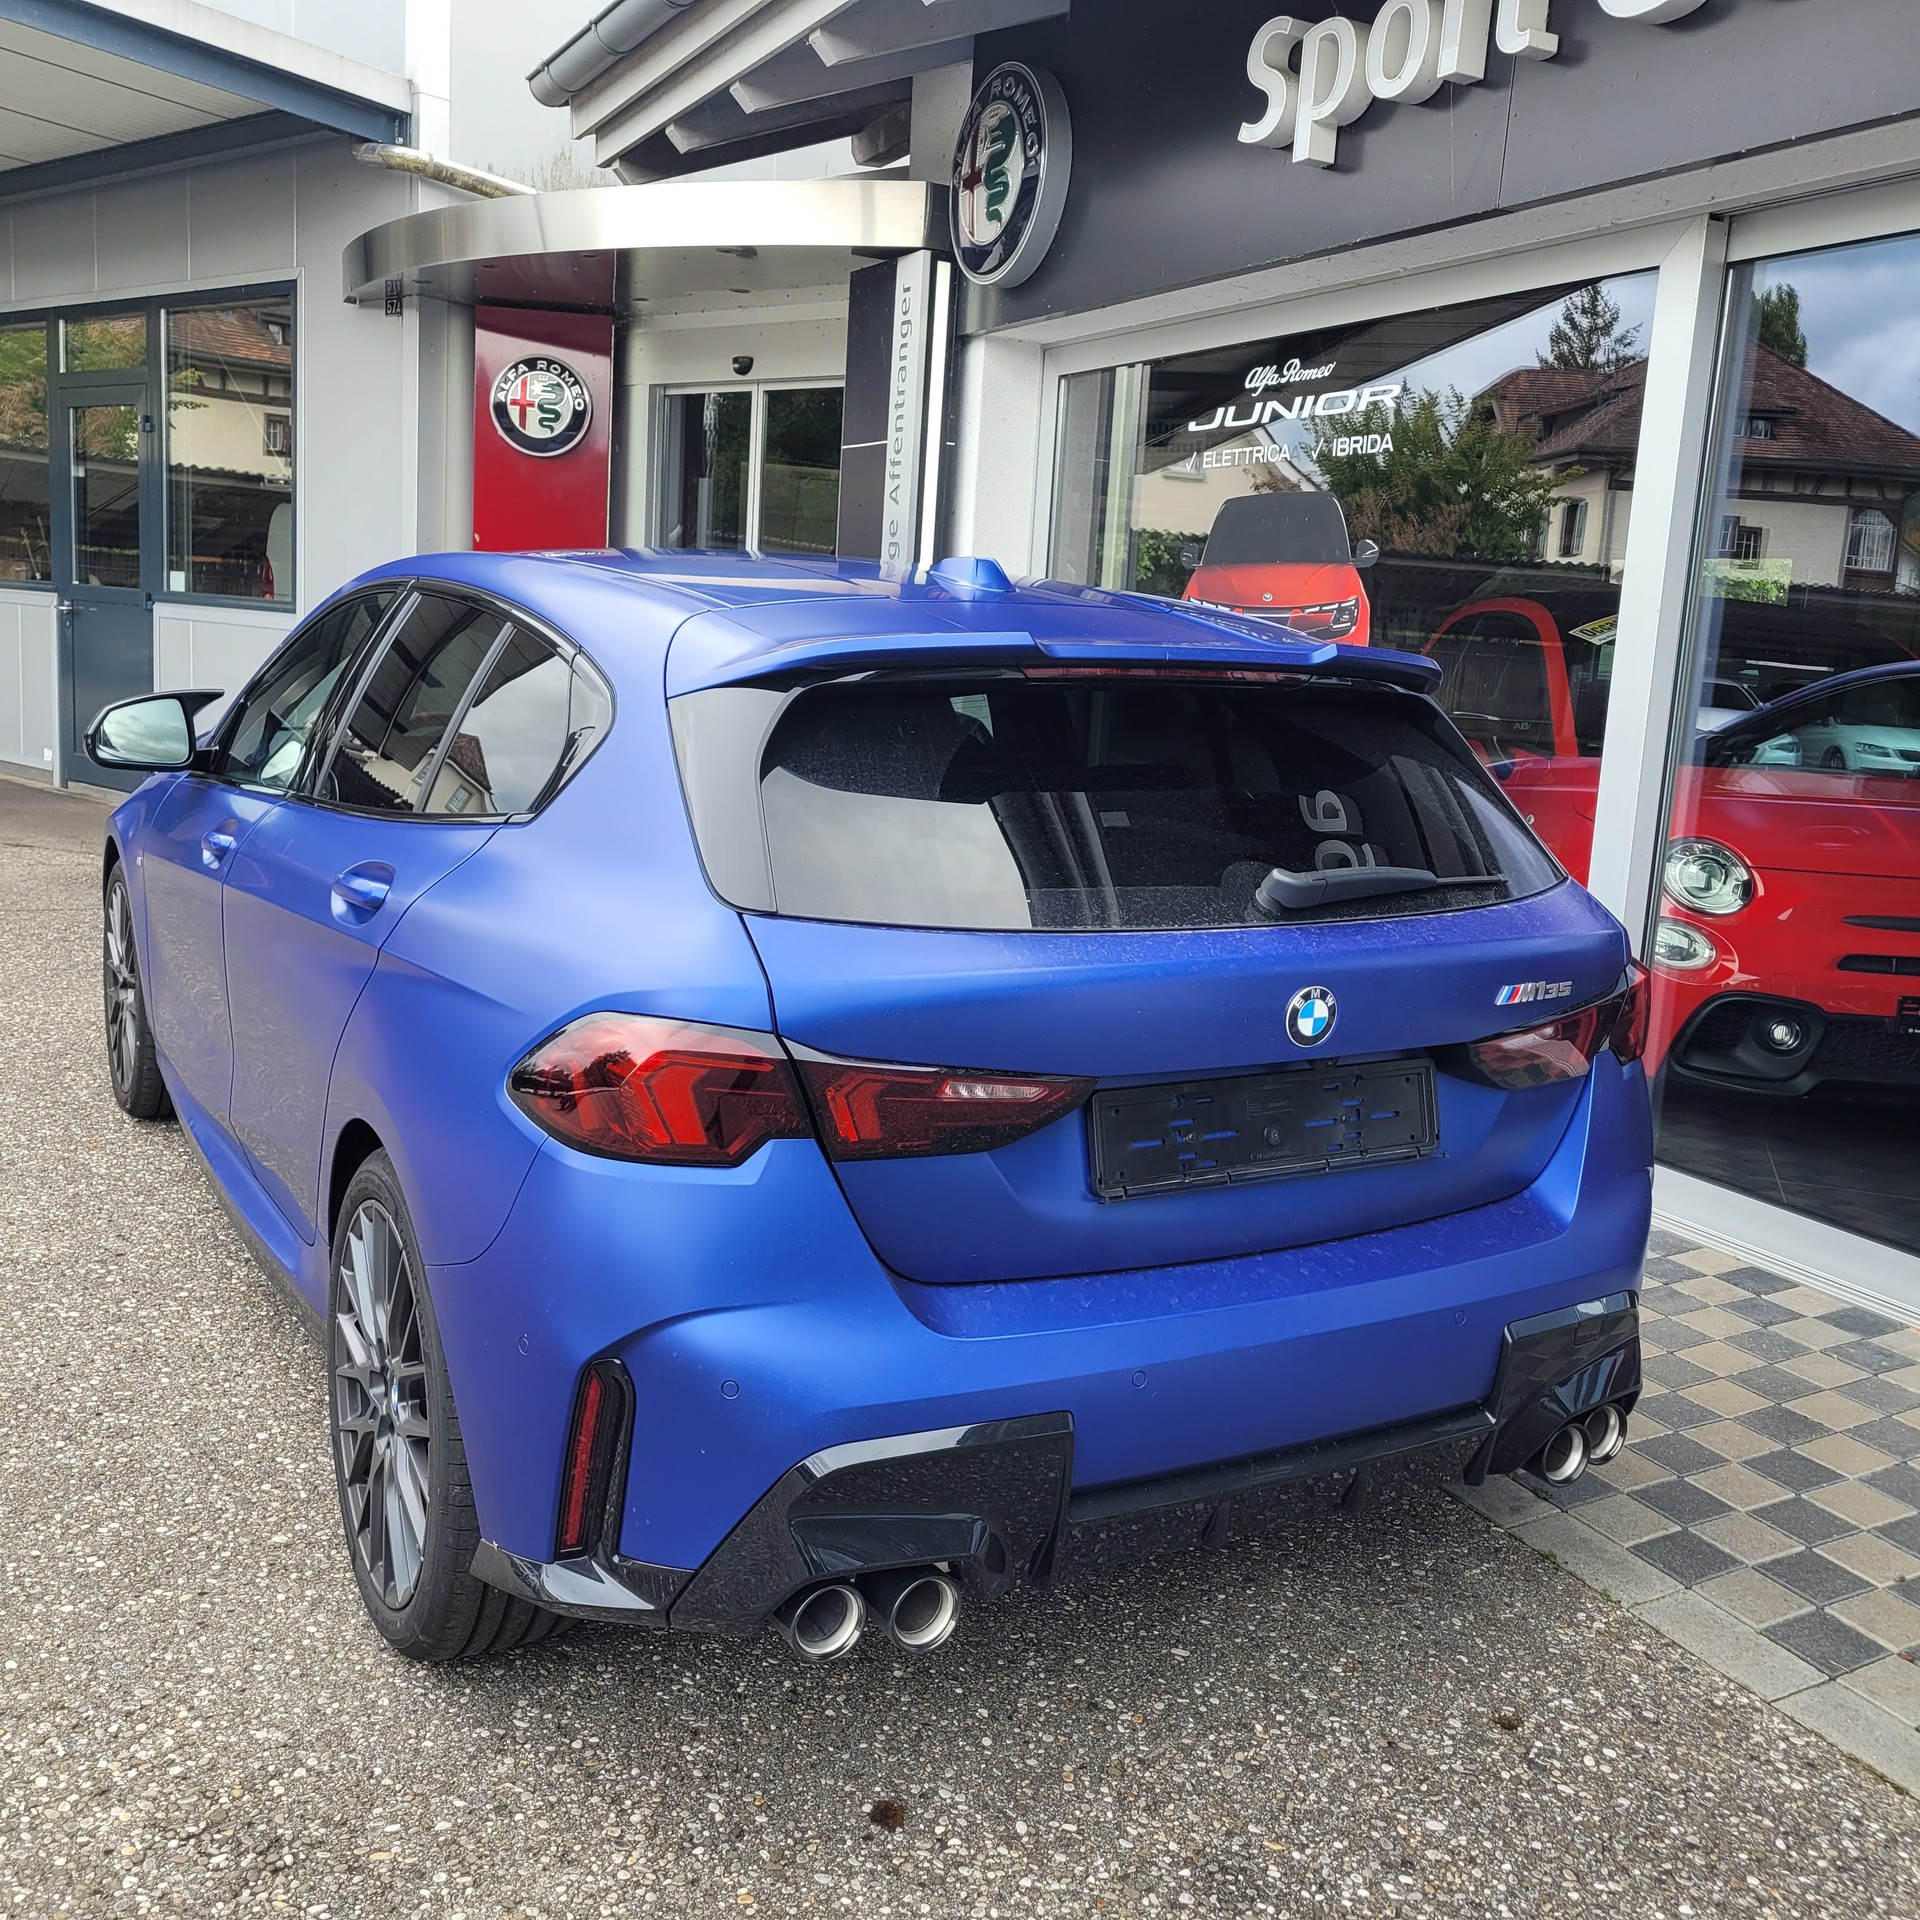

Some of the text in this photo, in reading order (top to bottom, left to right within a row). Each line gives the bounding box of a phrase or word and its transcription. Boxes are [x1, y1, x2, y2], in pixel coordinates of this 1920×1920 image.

[989, 77, 1039, 158] ROMEO
[497, 360, 585, 411] ALFA ROMEO
[888, 282, 913, 506] Affentranger
[1244, 357, 1336, 397] Alfa Romeo
[1188, 384, 1401, 432] JUNIOR
[1202, 443, 1291, 469] ELETTRICA
[1332, 433, 1394, 457] IBRIDA
[1294, 988, 1335, 1010] BMW
[1518, 980, 1573, 1003] M135
